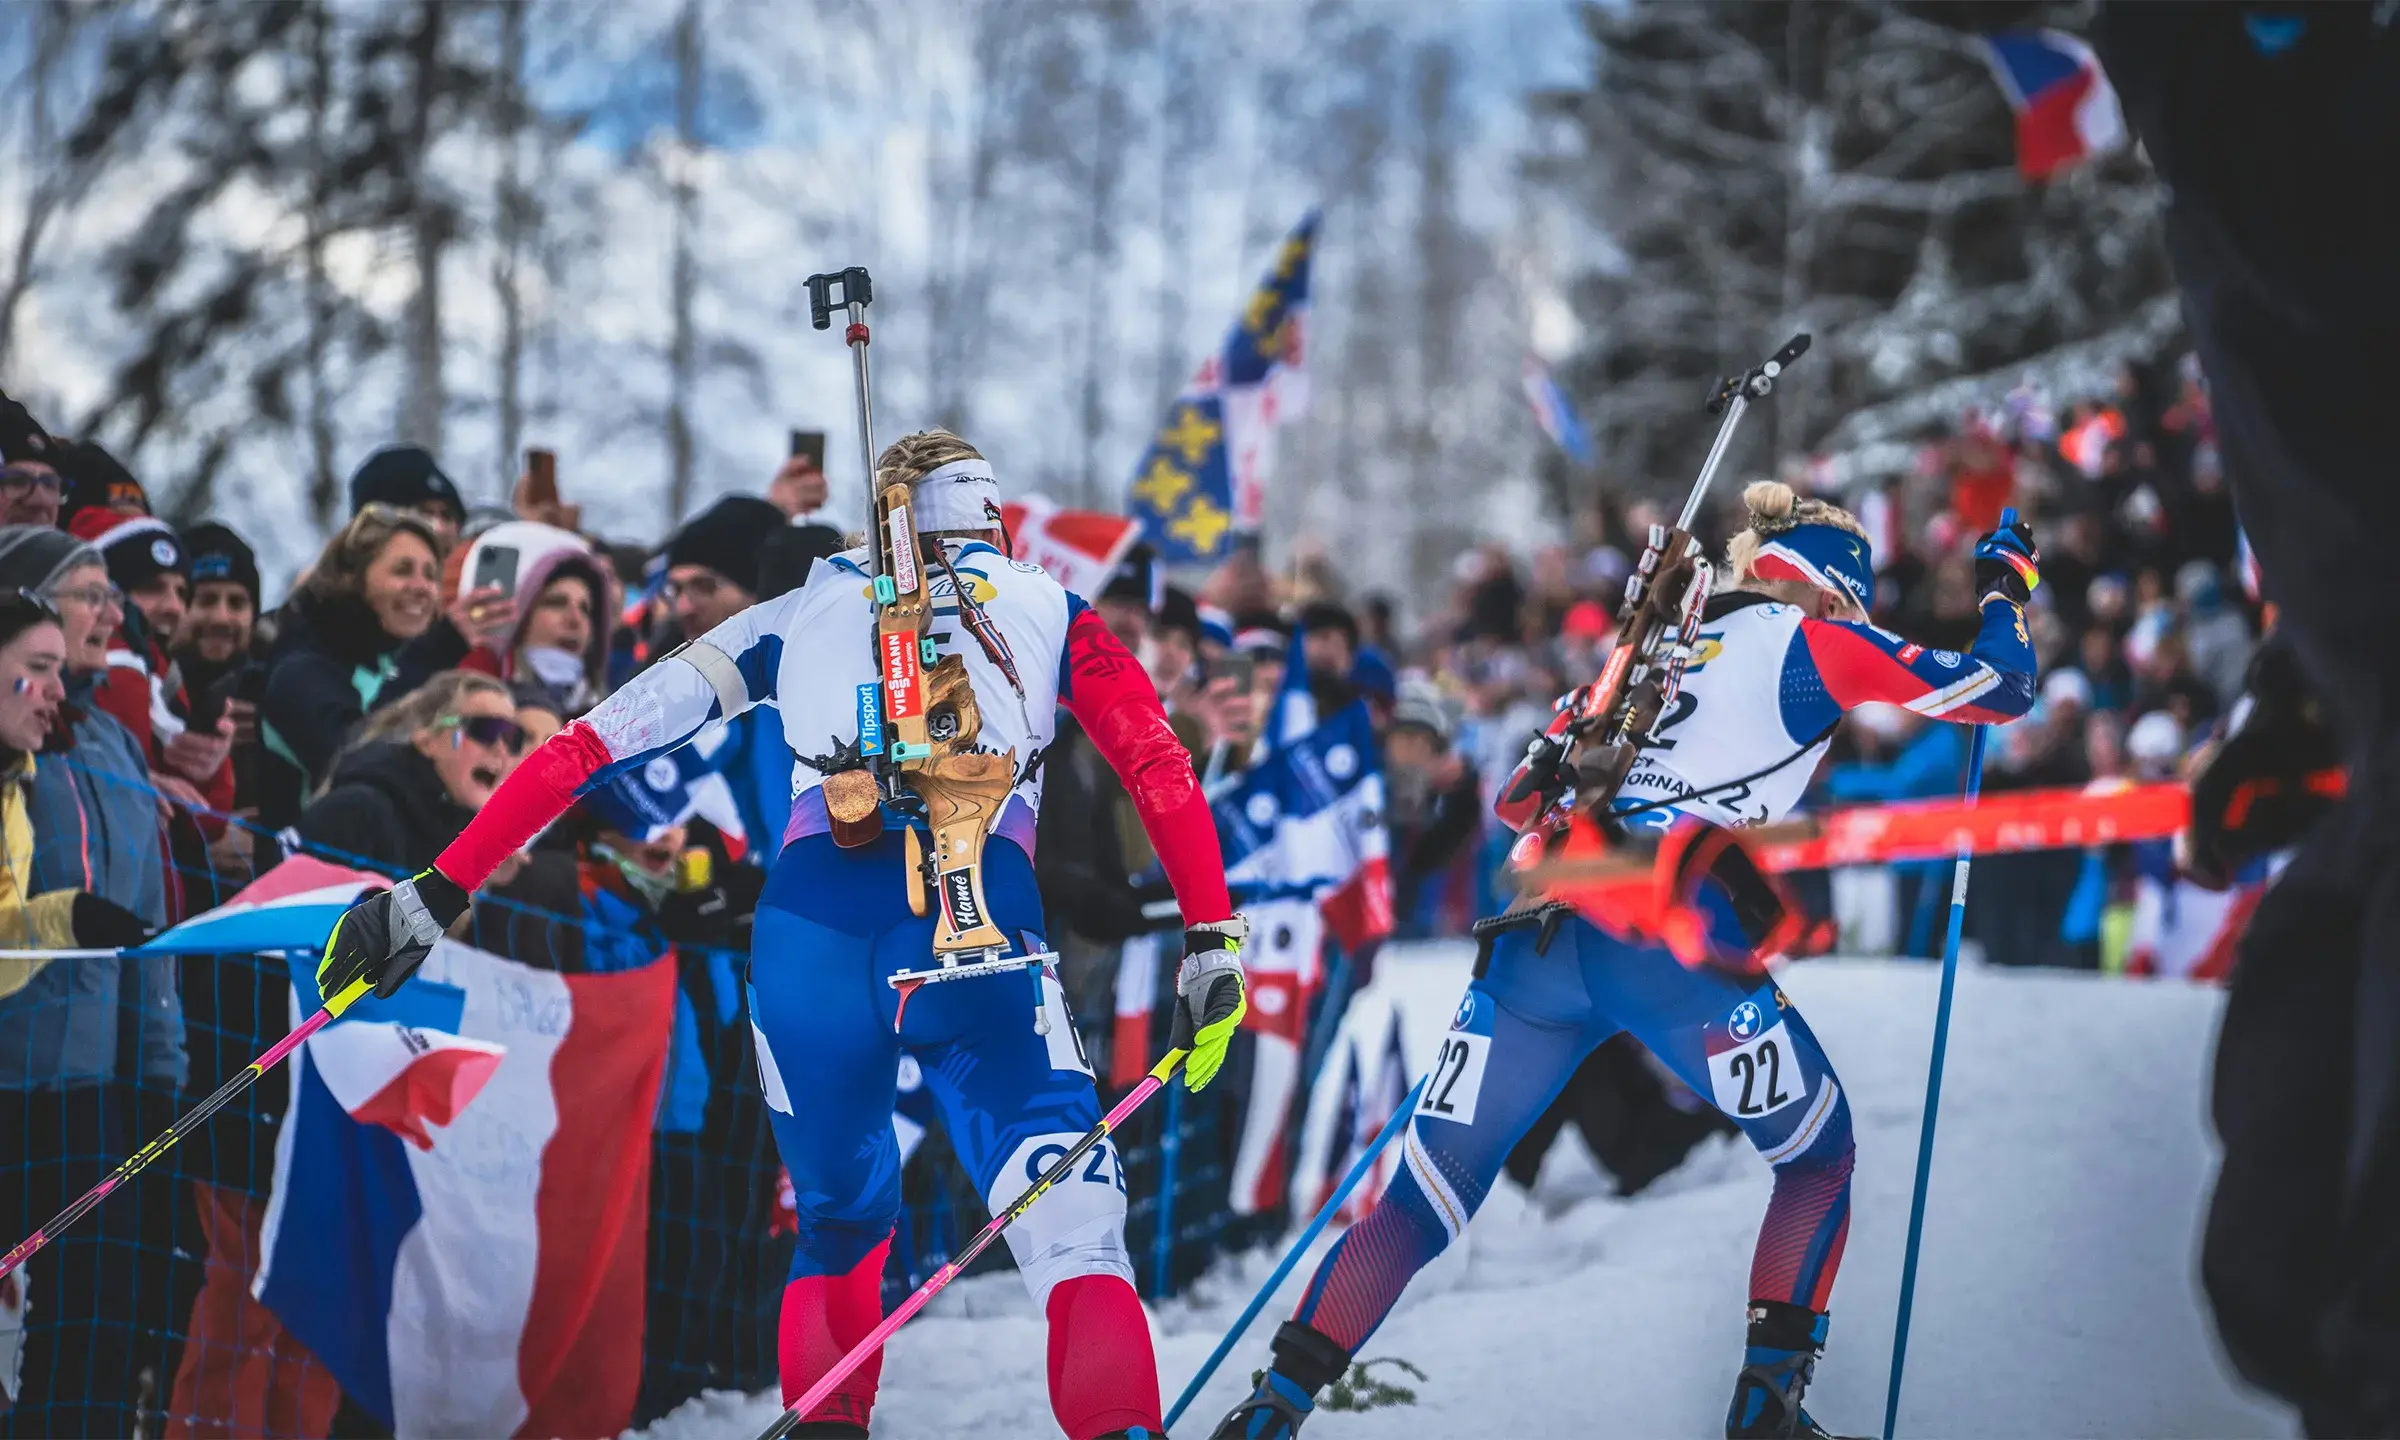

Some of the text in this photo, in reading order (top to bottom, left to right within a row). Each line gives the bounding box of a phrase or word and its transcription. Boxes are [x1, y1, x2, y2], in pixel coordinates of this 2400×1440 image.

[888, 634, 911, 716] VIESSMANN
[905, 642, 914, 663] pumps
[860, 686, 878, 738] Tipsport
[951, 875, 978, 925] Hamé
[1421, 1038, 1470, 1115] 22
[1729, 1040, 1788, 1115] 22
